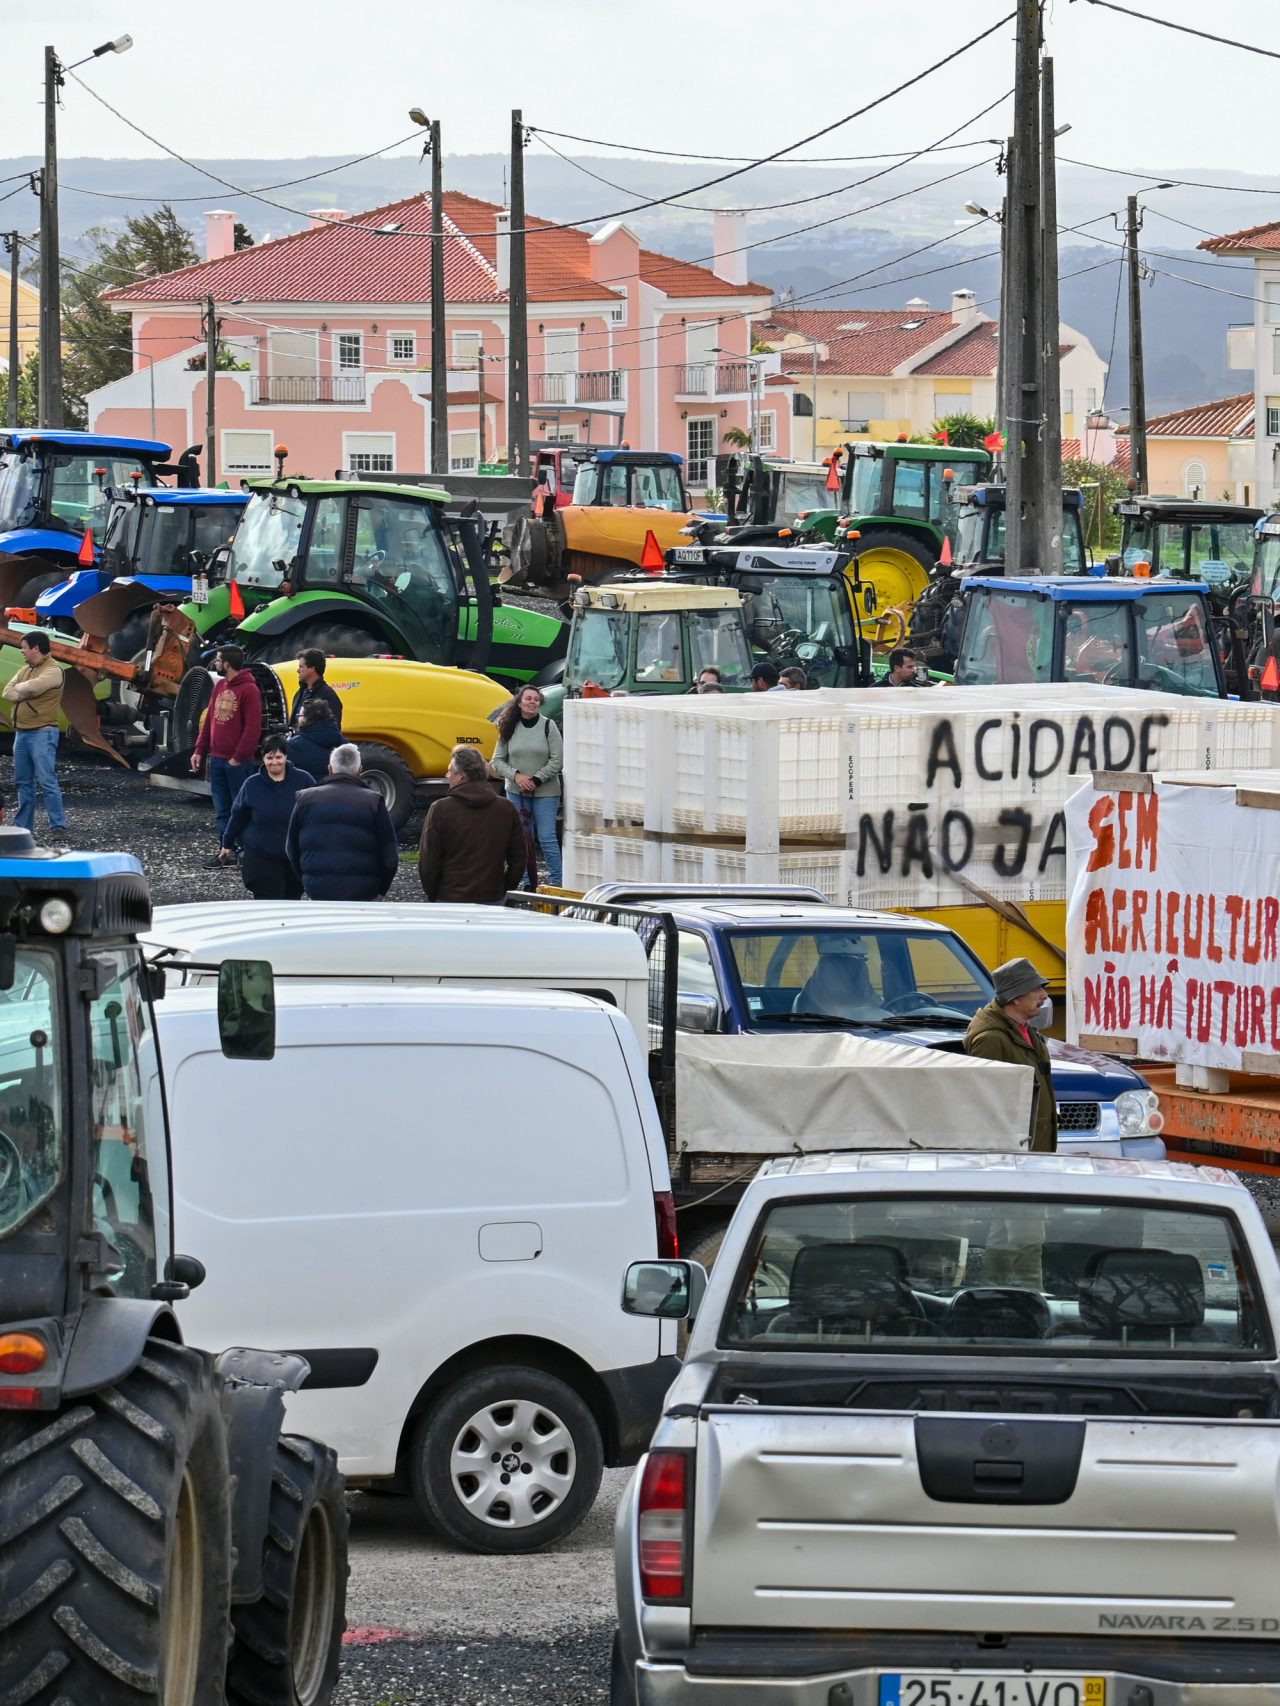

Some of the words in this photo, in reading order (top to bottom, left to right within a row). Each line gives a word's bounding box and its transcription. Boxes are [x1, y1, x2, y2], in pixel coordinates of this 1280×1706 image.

[926, 719, 962, 789] A
[856, 802, 974, 879] NÃO
[1086, 791, 1159, 872] SEM
[1084, 960, 1132, 1032] NÃO
[1099, 1614, 1206, 1630] NAVARA
[1213, 1617, 1255, 1631] 2.5
[1085, 1684, 1102, 1695] 03
